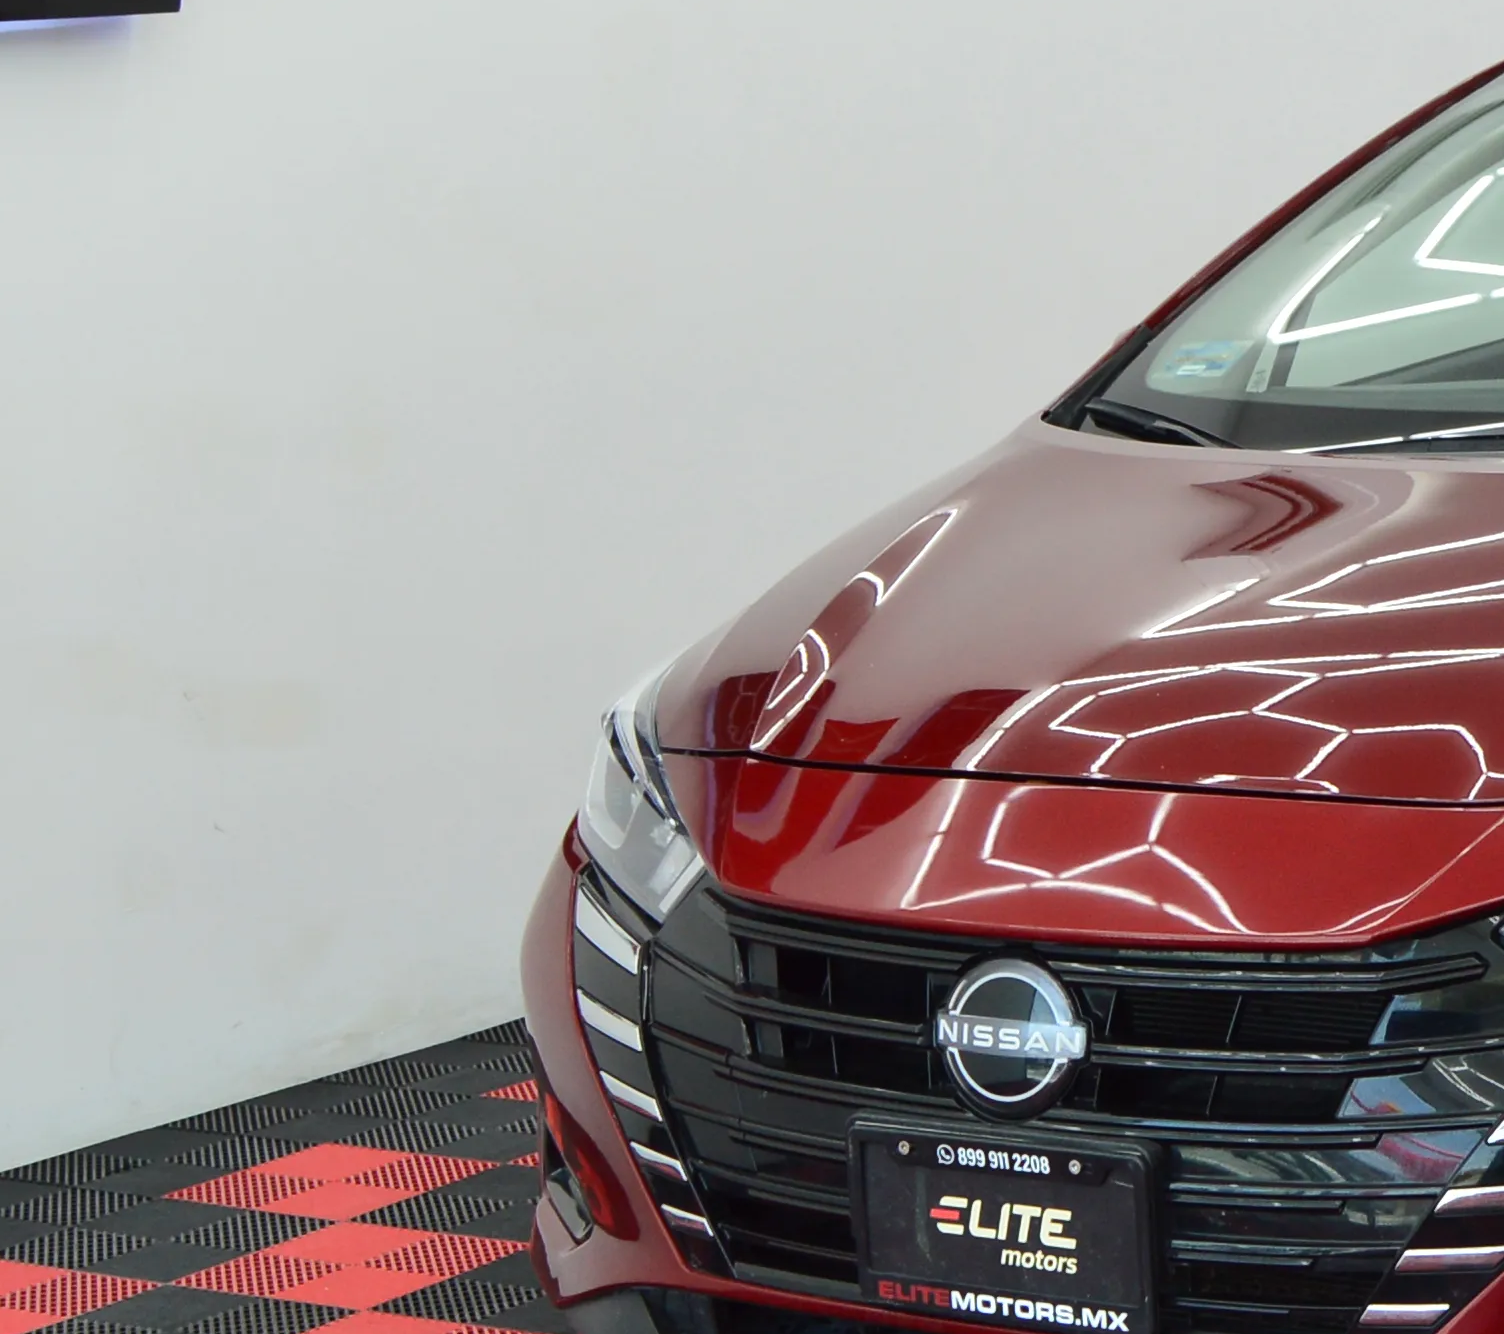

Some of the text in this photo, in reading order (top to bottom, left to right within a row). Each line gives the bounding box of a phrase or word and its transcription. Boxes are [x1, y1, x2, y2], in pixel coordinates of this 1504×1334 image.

[938, 1018, 1081, 1054] NISSAN
[956, 1146, 1051, 1175] 899 911 2208
[930, 1195, 1078, 1250] ELITE
[1000, 1247, 1078, 1275] motors
[877, 1279, 1131, 1333] ELITEMOTORS.MX
